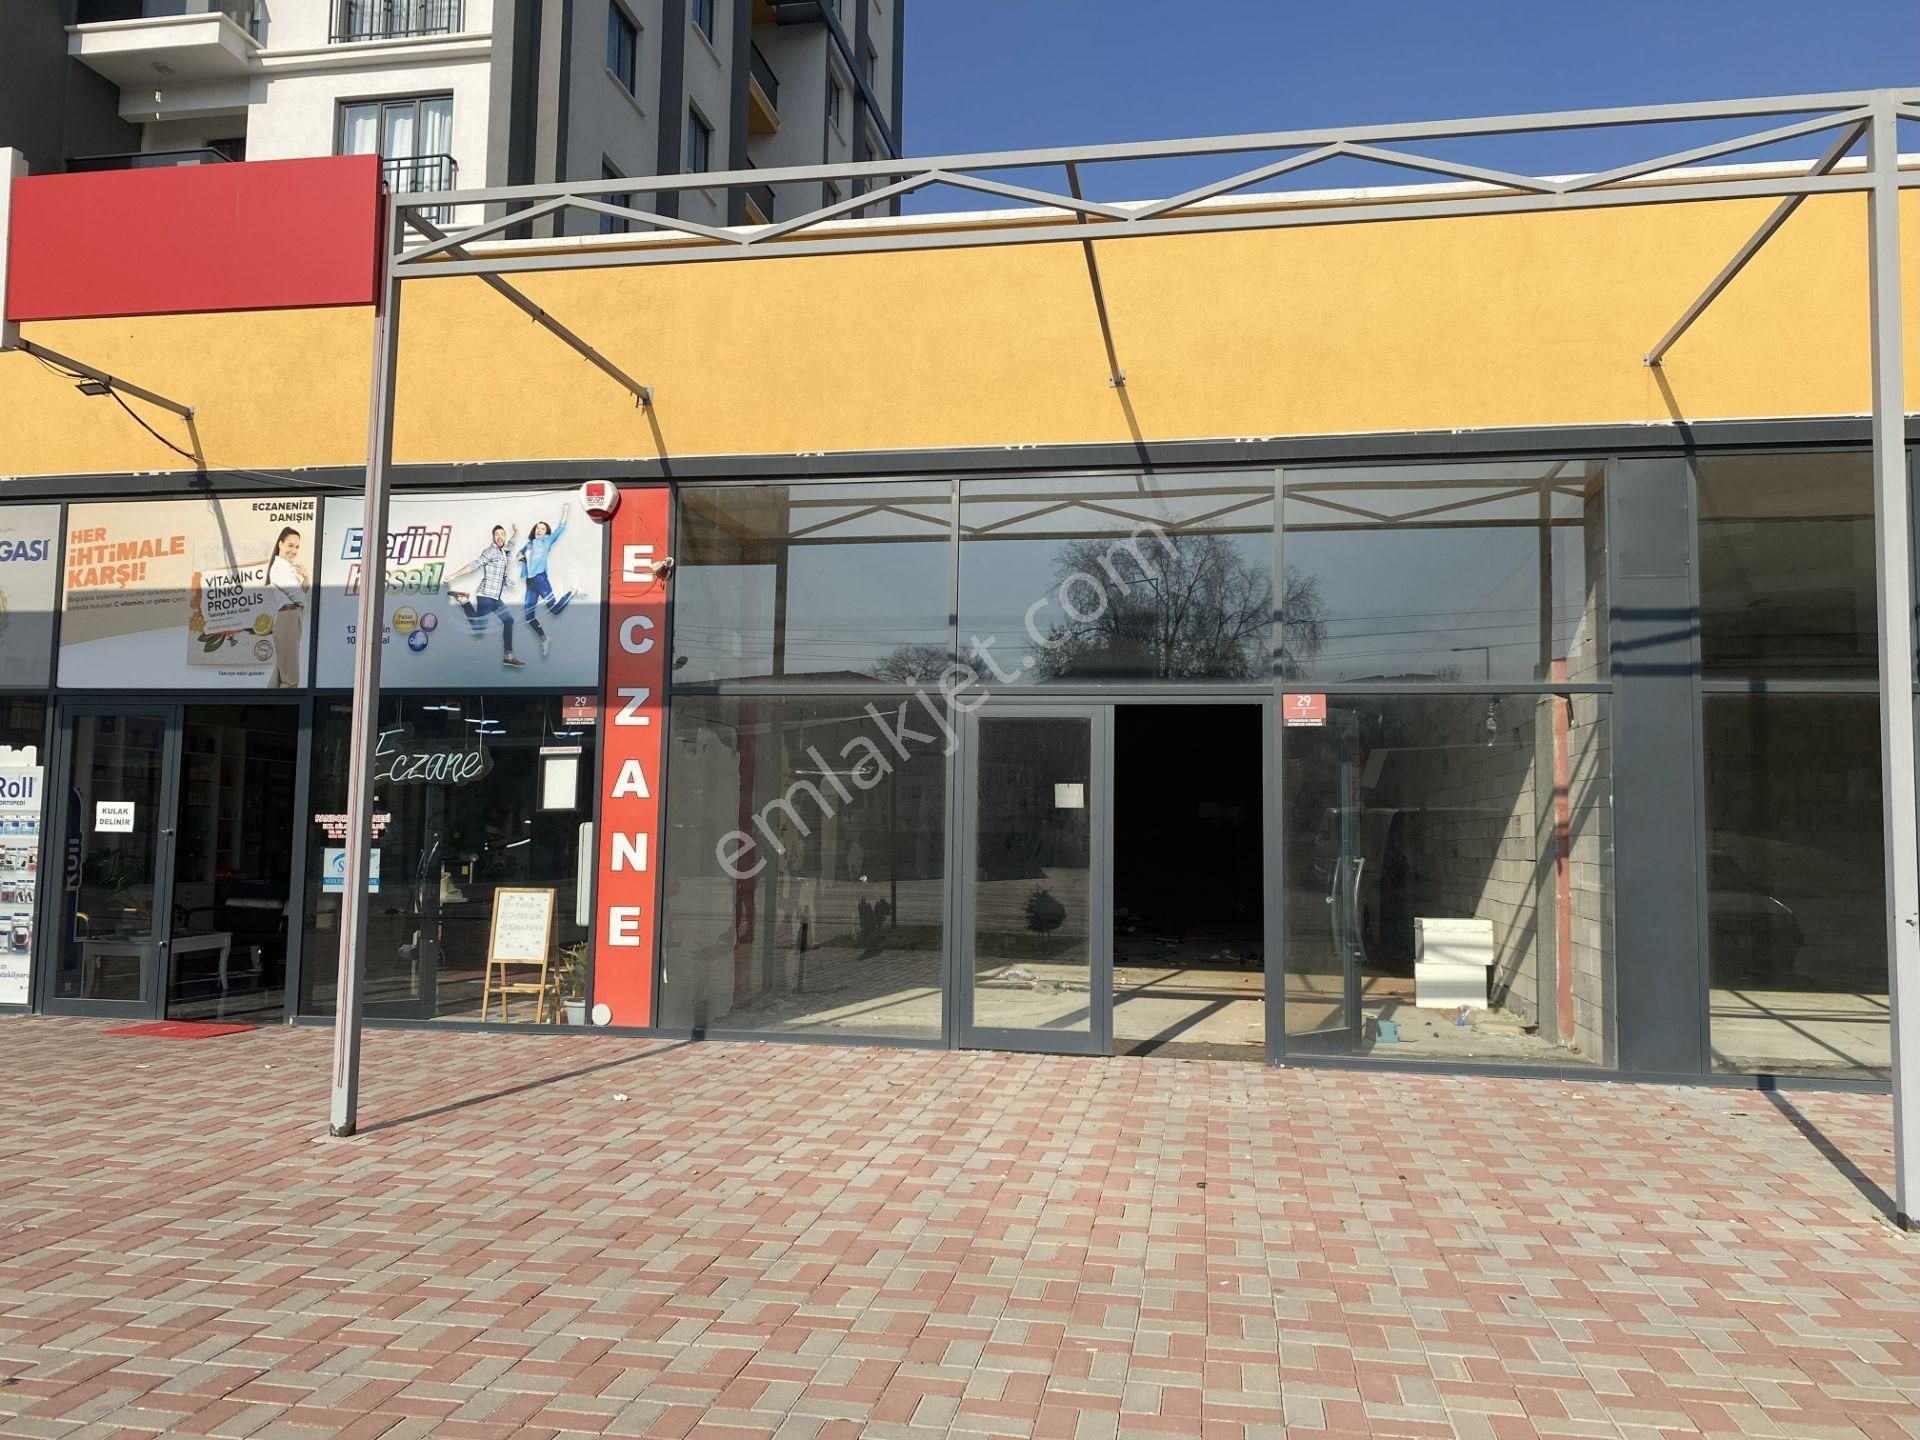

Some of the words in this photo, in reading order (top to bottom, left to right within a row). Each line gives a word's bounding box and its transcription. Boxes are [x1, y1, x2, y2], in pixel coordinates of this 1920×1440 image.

[252, 500, 314, 511] ECZANENİZE
[270, 513, 313, 523] DANIŞIN
[71, 528, 106, 544] HER
[341, 525, 452, 565] Eerjini
[68, 562, 146, 588] KARŞI!
[205, 571, 252, 587] VİTAMİN
[255, 570, 264, 580] C
[207, 585, 243, 600] ÇİNKO
[208, 593, 264, 611] PROPOLİS
[347, 625, 356, 633] 13
[575, 696, 587, 706] 29
[1297, 695, 1311, 706] 29
[611, 545, 654, 946] ECZANE
[315, 814, 348, 822] PANDOR
